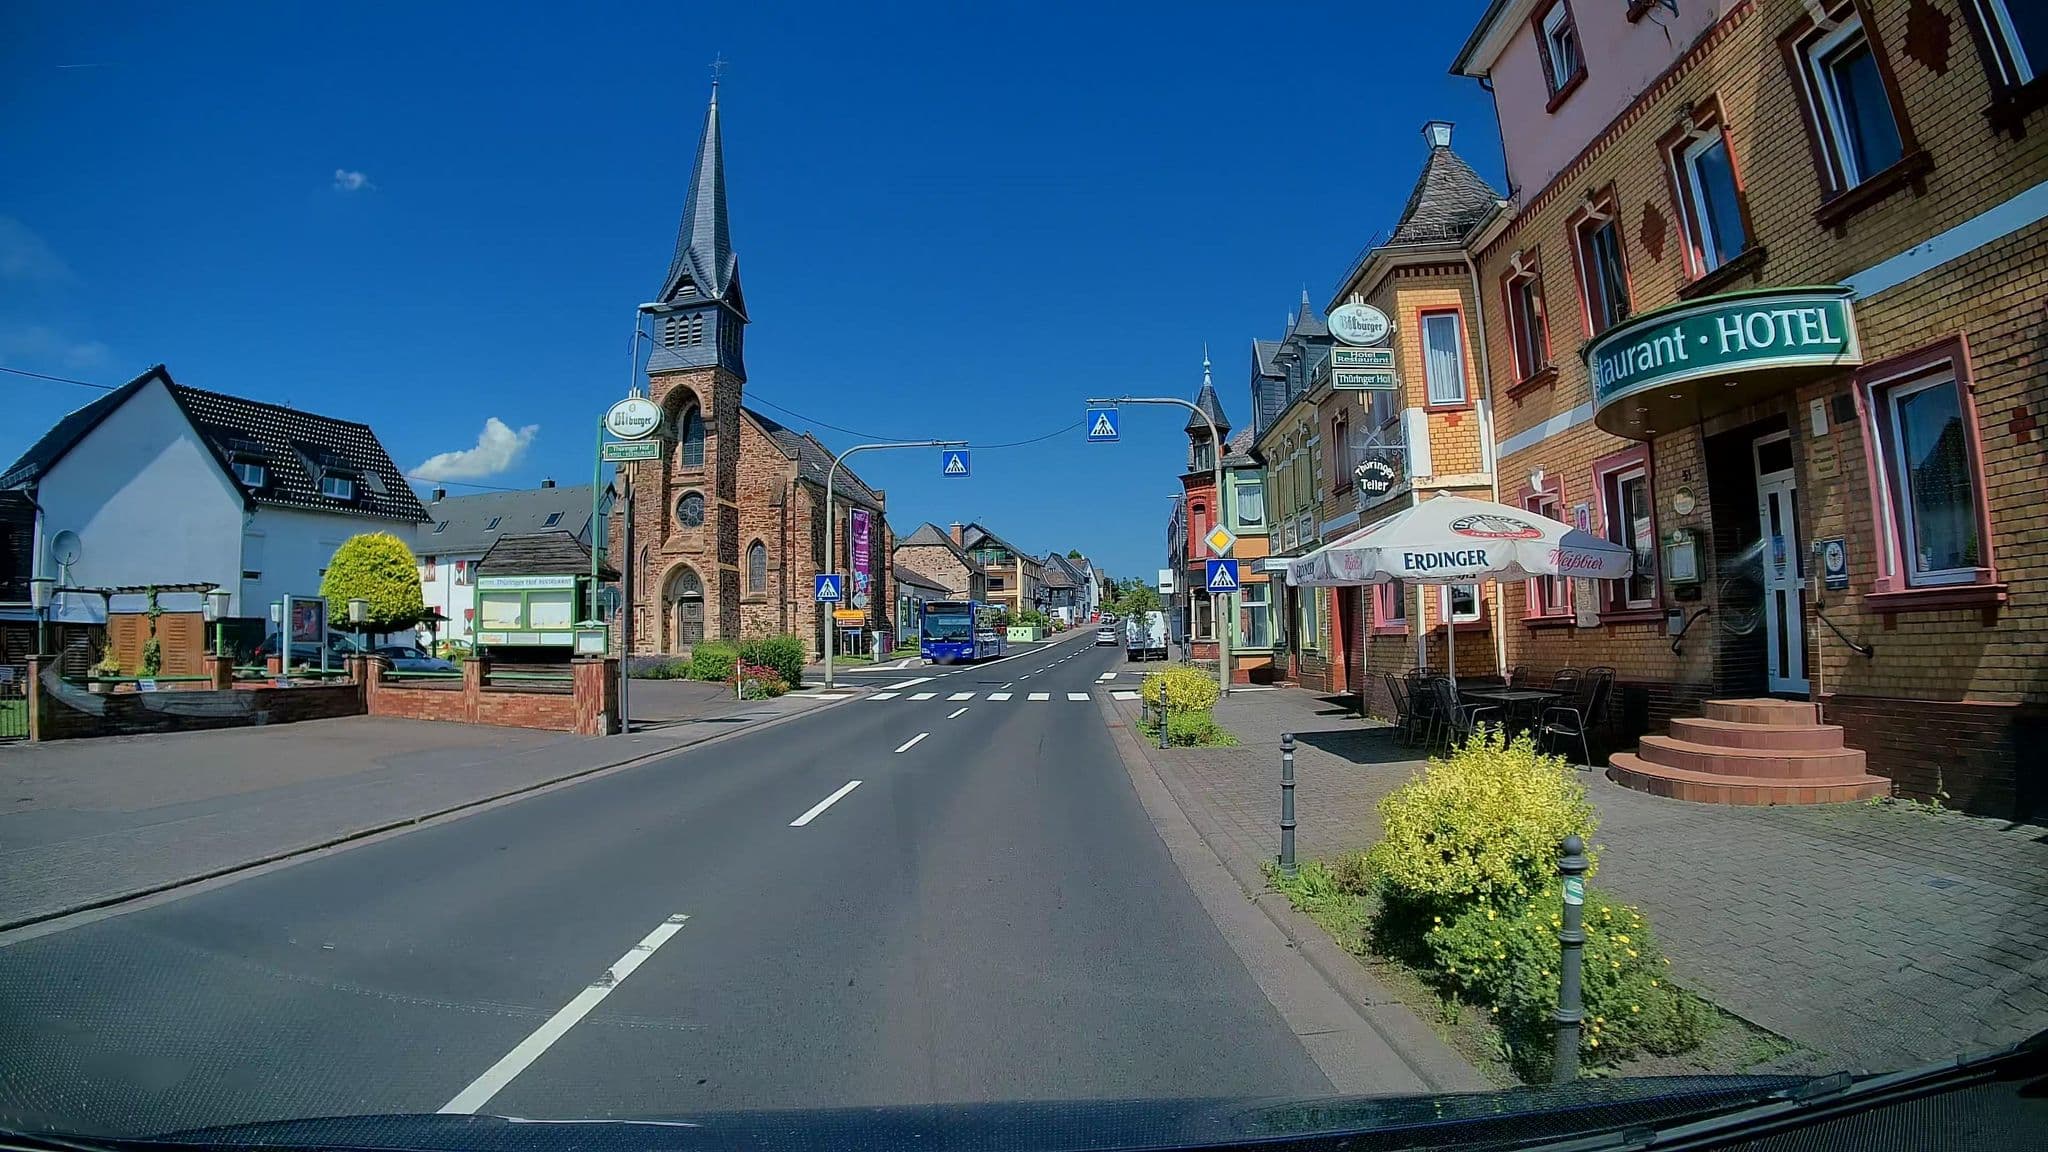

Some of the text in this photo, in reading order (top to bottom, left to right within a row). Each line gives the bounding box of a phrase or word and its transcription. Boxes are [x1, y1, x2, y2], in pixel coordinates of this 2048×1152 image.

[1717, 307, 1841, 354] HOTEL
[1338, 374, 1375, 385] Thüringer
[1354, 458, 1395, 480] Thüringer
[1360, 478, 1389, 492] Teller
[1403, 549, 1490, 571] ERDINGER
[1548, 548, 1605, 572] Weißbier
